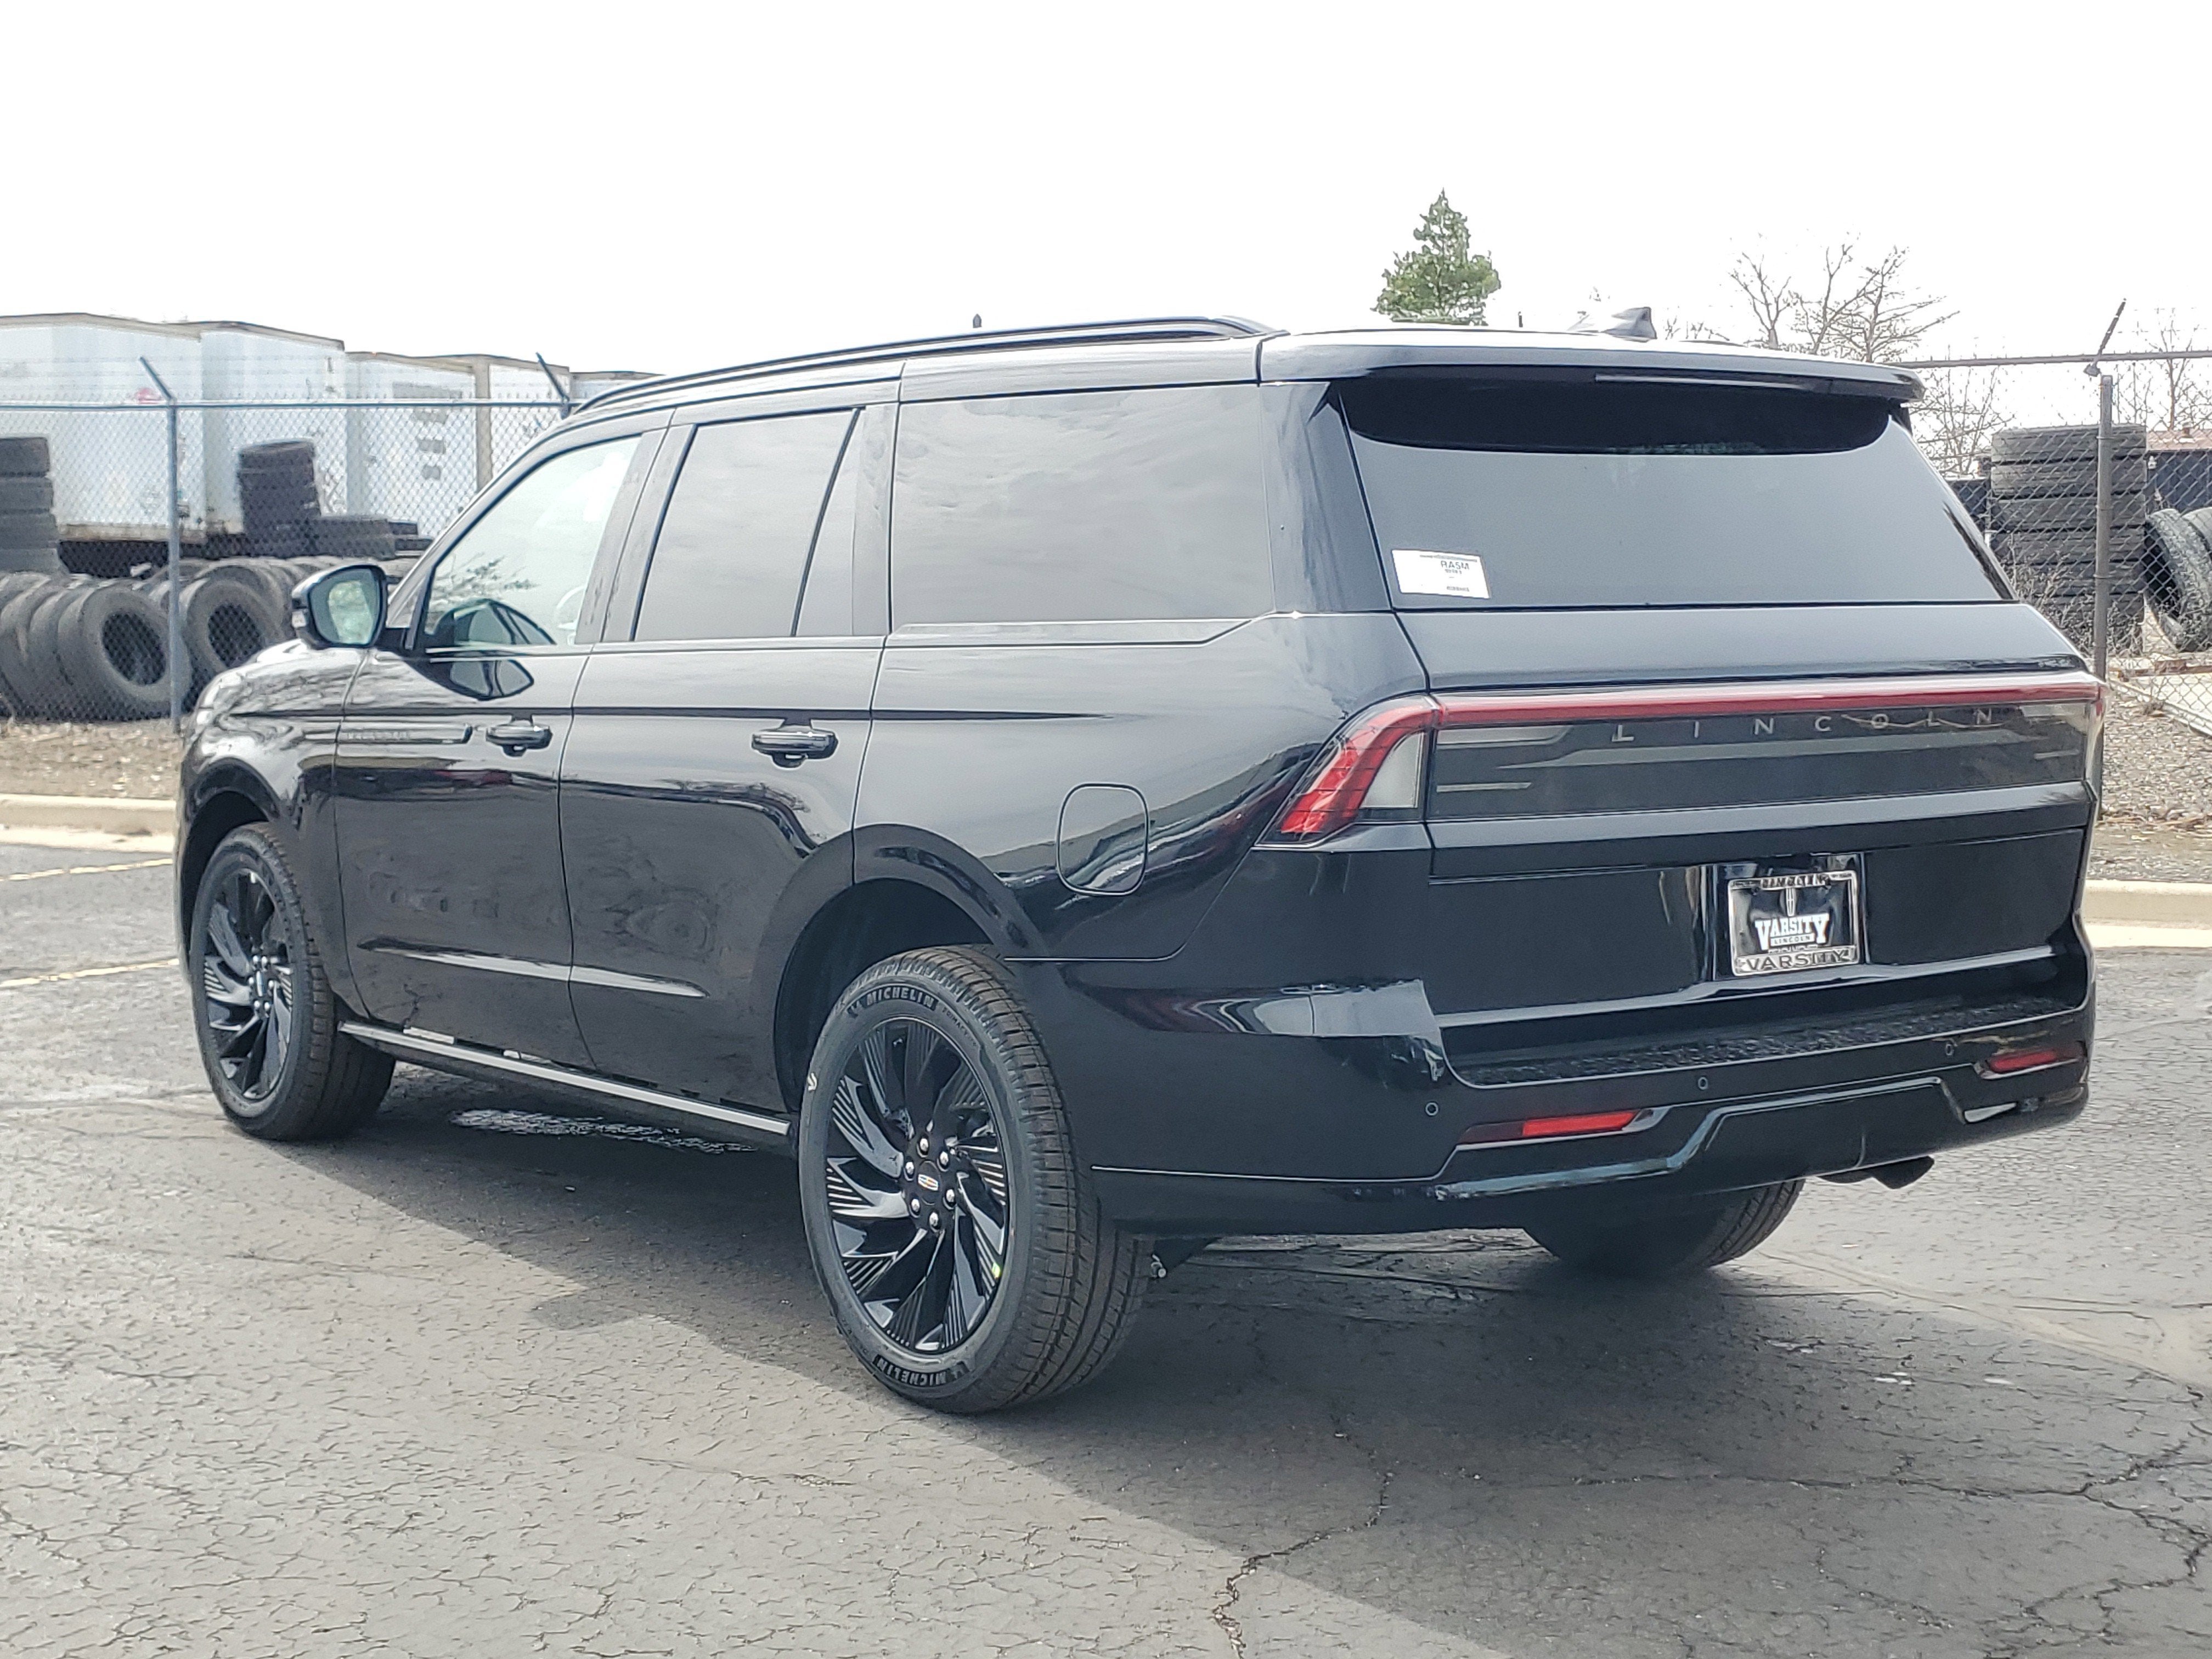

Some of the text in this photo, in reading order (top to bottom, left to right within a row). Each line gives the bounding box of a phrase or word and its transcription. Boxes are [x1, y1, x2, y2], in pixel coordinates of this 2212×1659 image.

[1611, 708, 1993, 742] LINCOLN
[1755, 913, 1830, 950] VARSITY
[1774, 935, 1810, 944] LINCOLN
[1745, 949, 1846, 970] VARSITY
[866, 986, 934, 1008] MICHELIN
[877, 1357, 946, 1386] MICHELIN
